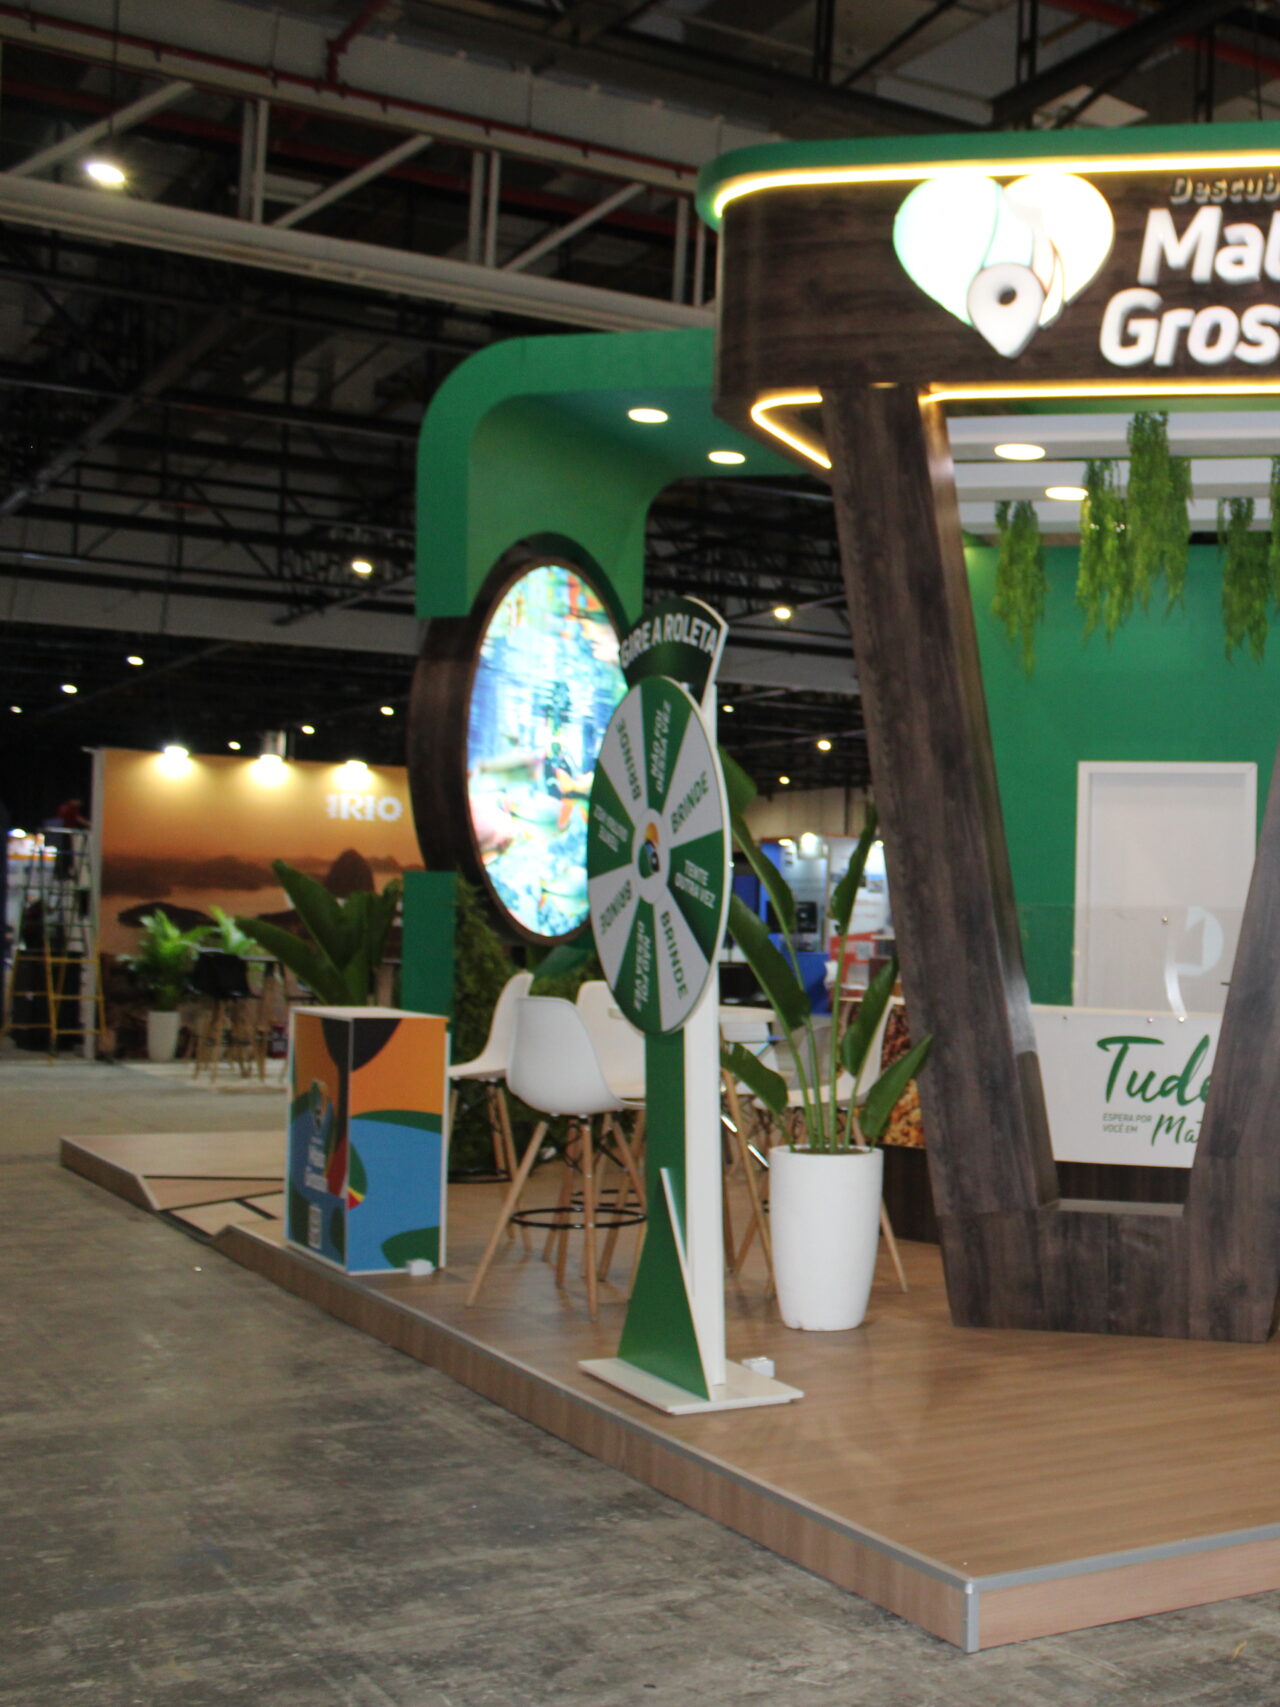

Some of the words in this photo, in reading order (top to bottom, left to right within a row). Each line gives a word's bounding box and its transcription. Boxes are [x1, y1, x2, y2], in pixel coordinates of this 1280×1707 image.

[620, 621, 651, 669] GIRE
[652, 616, 662, 645] A
[664, 613, 717, 657] ROLETA
[341, 794, 402, 821] RIO
[671, 770, 708, 834] BRINDE
[660, 911, 689, 999] BRINDE
[1103, 1112, 1134, 1122] ESPERA
[1135, 1113, 1153, 1123] POR
[1103, 1123, 1123, 1133] VOCÊ
[1125, 1125, 1138, 1133] EM
[1151, 1113, 1201, 1146] Ma
